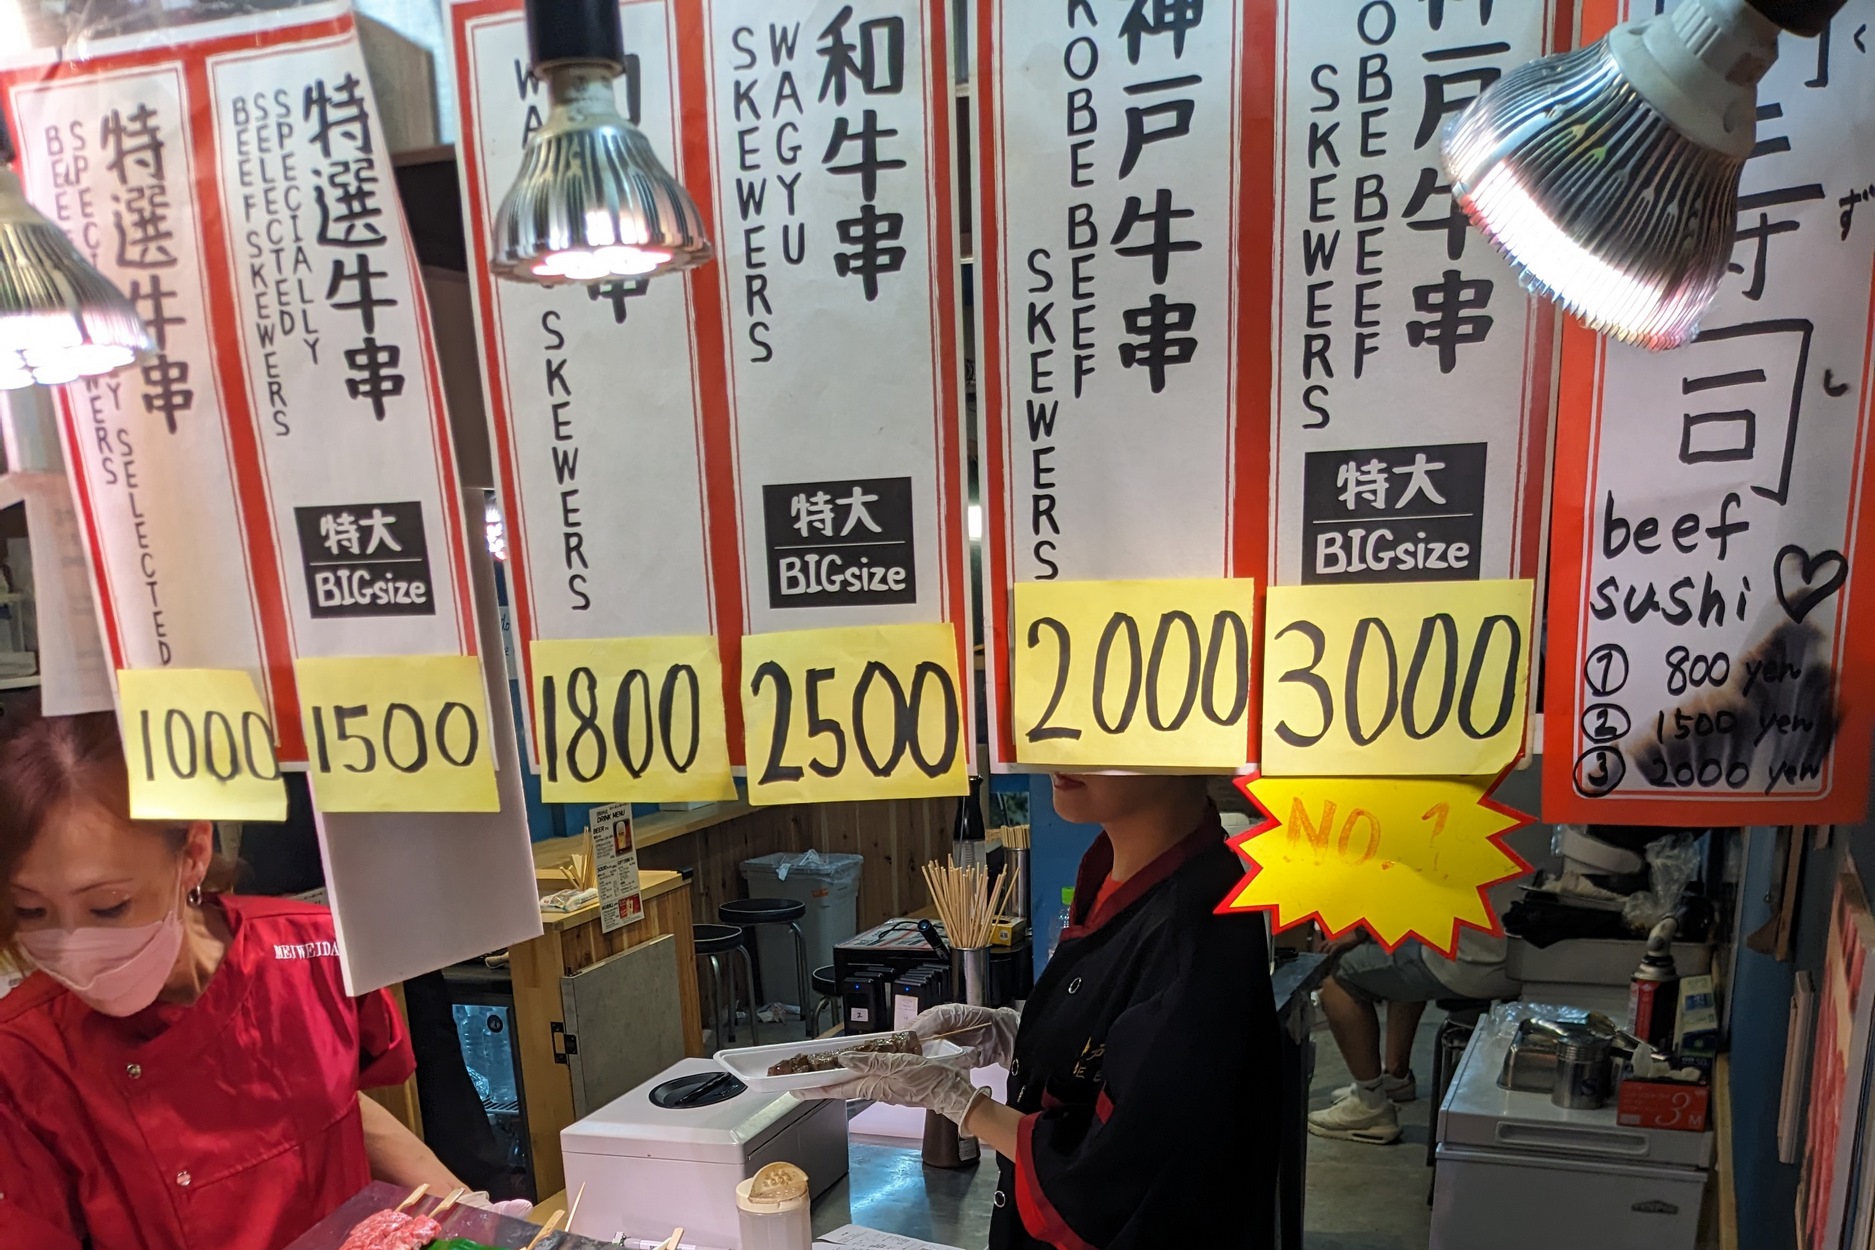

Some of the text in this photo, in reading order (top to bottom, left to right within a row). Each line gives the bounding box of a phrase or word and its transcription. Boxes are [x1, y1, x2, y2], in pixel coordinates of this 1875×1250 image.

[731, 26, 774, 363] SKEWERS
[769, 21, 805, 265] WAGYU
[816, 4, 907, 301] 和牛串
[1063, 0, 1099, 399] KOBE BEEF
[1110, 0, 1203, 394] 神戸牛串
[232, 97, 290, 436] BEEF SKEWERS
[253, 92, 294, 336] SELECTED
[273, 89, 320, 365] SPECIALLY
[303, 72, 405, 421] 特選牛串
[1301, 64, 1341, 430] SKEWERS
[1353, 174, 1389, 380] BEEF
[541, 310, 592, 611] SKEWERS
[1026, 248, 1060, 580] SKEWERS
[319, 508, 402, 555] 特大
[790, 487, 883, 538] 特大
[1336, 453, 1447, 511] 特大
[1603, 490, 1750, 560] beef
[1590, 571, 1751, 628] sushi
[311, 701, 479, 774] 1500
[543, 663, 700, 783] 1800
[751, 660, 960, 785] 2500
[1028, 610, 1249, 743] 2000
[1274, 614, 1522, 748] 3000
[1656, 708, 1738, 744] 1500
[1753, 711, 1814, 747] yen
[1665, 646, 1730, 696] 800
[1743, 656, 1802, 698] yen
[140, 707, 282, 782] 1000
[1649, 758, 1750, 789] 2000
[1764, 759, 1821, 796] yen
